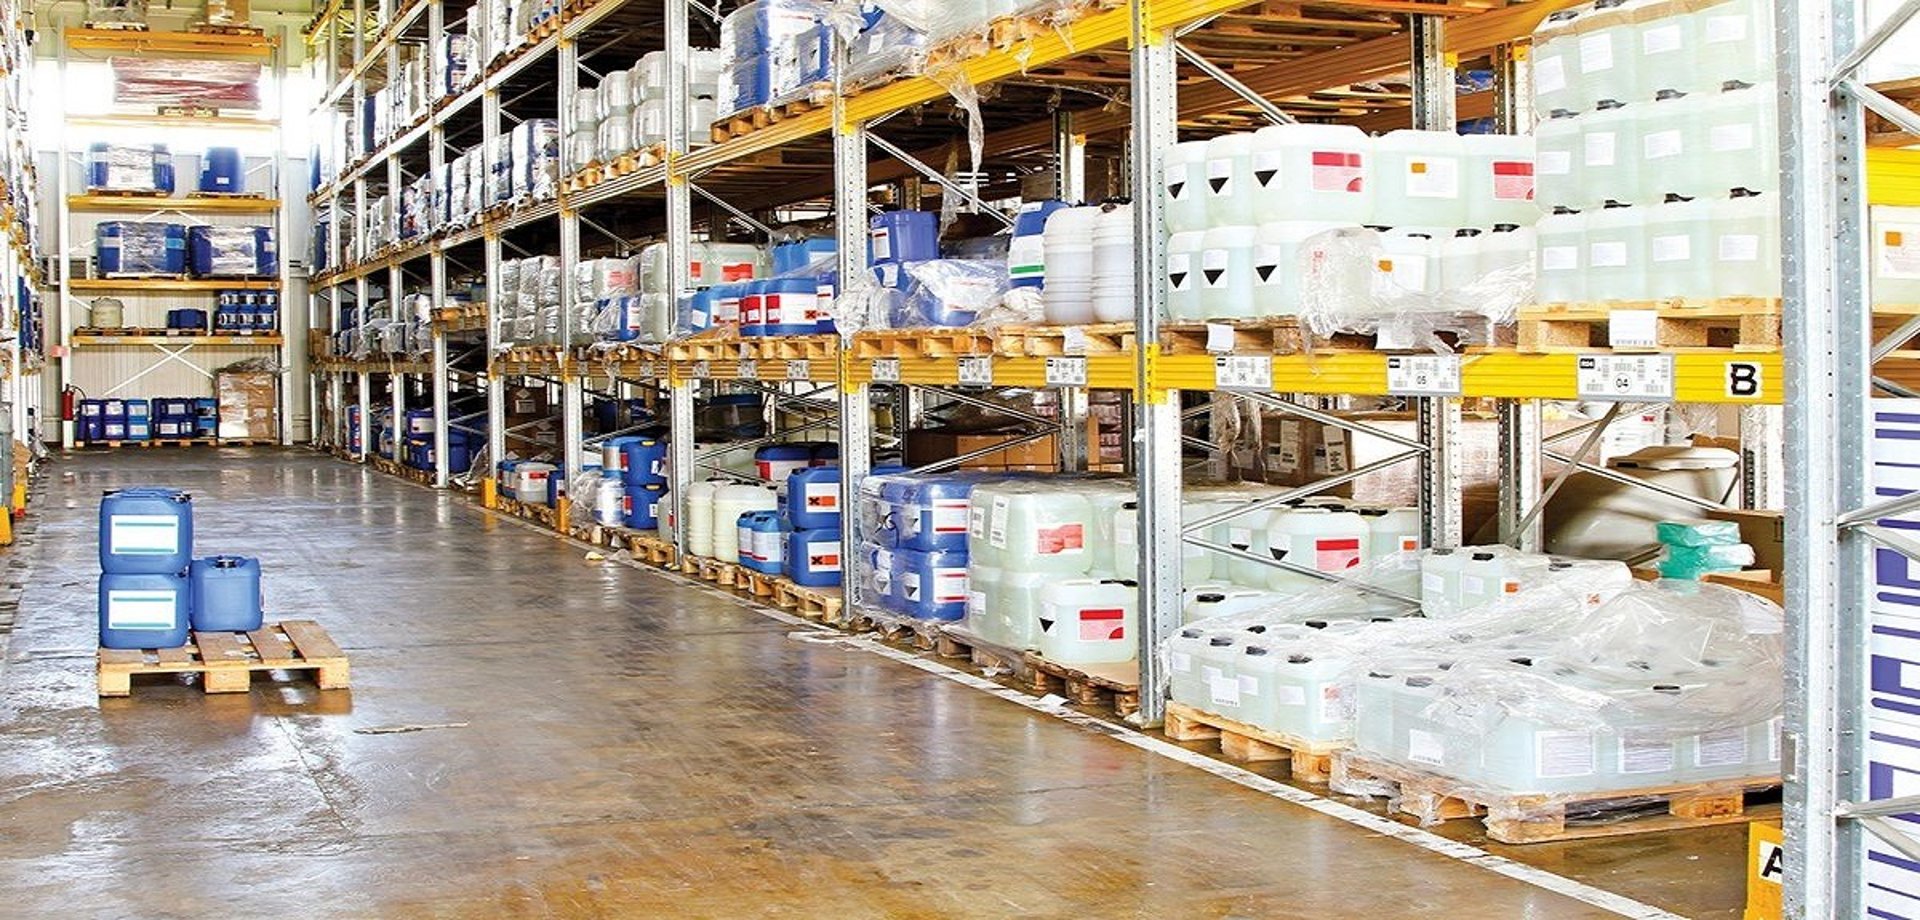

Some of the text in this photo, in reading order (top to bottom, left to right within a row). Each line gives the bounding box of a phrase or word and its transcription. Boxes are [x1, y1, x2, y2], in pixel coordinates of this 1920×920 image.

[1615, 378, 1629, 388] 04
[1730, 363, 1757, 396] B
[1762, 846, 1782, 877] A
